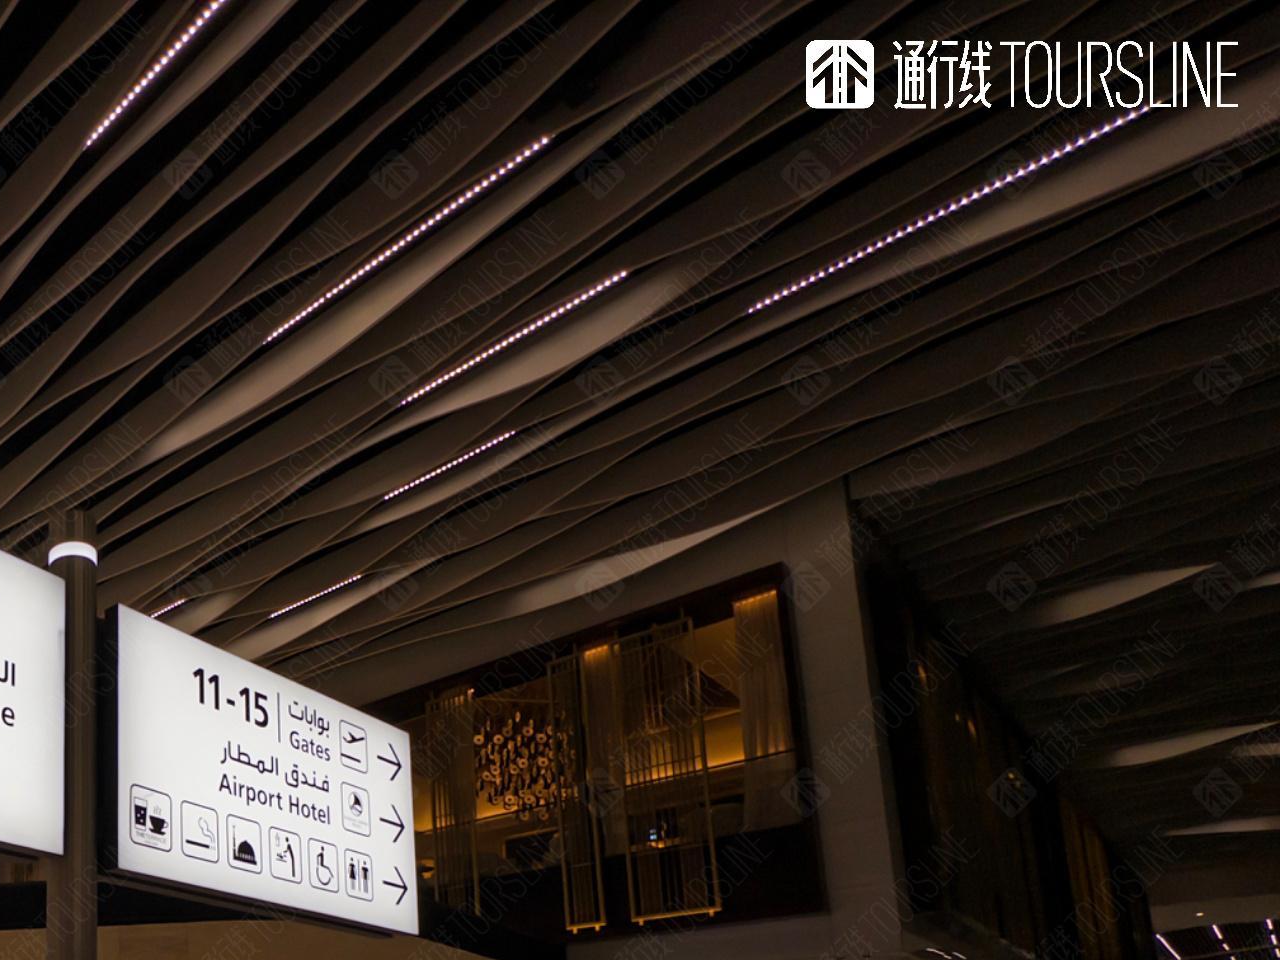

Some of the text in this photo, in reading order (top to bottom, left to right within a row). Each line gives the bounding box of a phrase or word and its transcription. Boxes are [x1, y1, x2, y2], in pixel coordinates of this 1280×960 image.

[192, 667, 269, 728] 11-15
[288, 700, 330, 738] بوابات
[220, 741, 330, 793] فندق المطار
[289, 730, 331, 762] Gates
[218, 773, 331, 825] Airport Hotel
